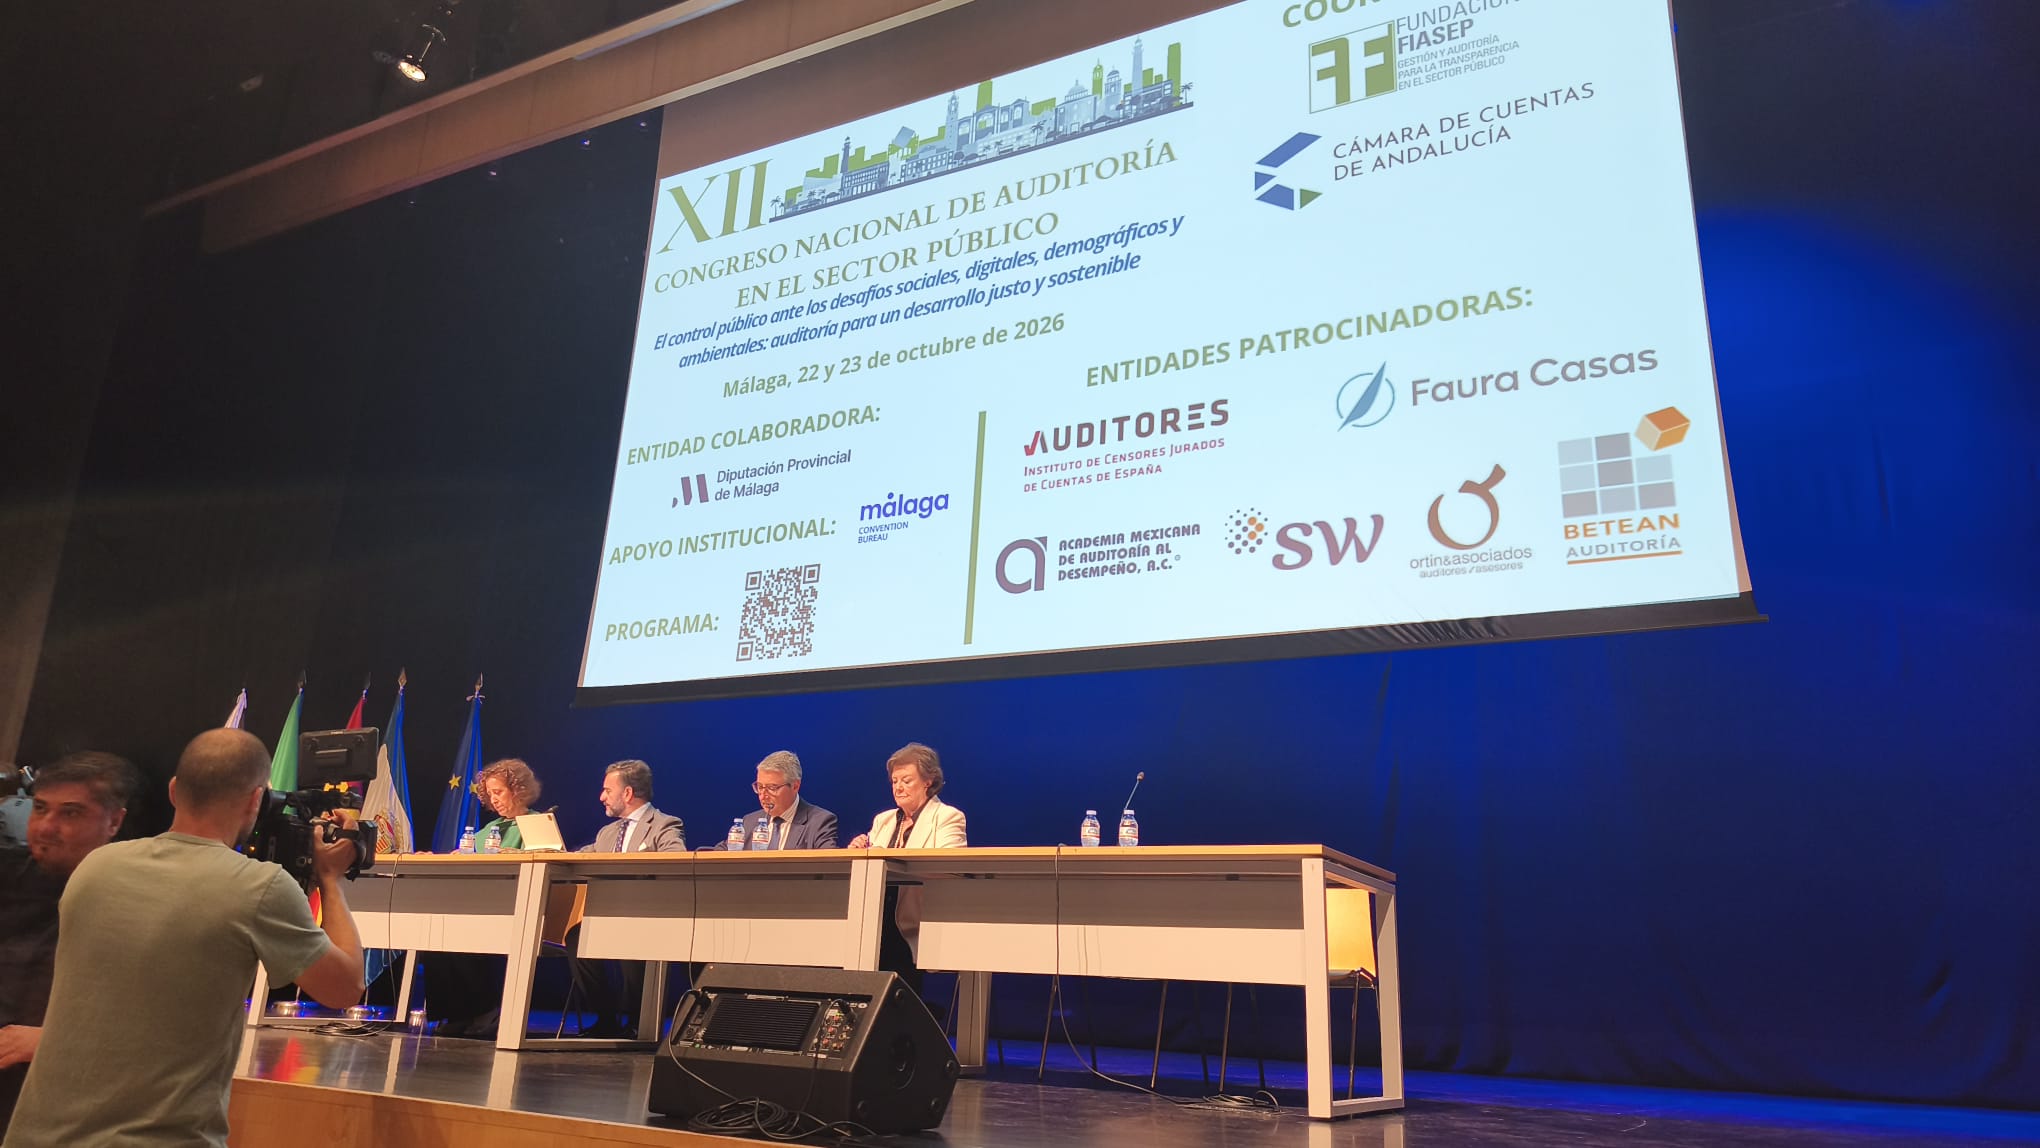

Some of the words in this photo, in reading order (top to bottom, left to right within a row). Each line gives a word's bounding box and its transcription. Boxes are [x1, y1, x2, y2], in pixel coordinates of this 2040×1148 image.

[1283, 0, 1380, 27] COO
[1396, 0, 1519, 34] FUNDACI
[1398, 18, 1474, 54] FIASEP
[1398, 50, 1437, 69] GESTIÓN
[1439, 48, 1445, 57] Y
[1447, 34, 1499, 55] AUDITORÍA
[1399, 66, 1423, 79] PARA
[1425, 63, 1437, 73] LA
[1439, 40, 1520, 68] TRANSPARENCIA
[1399, 80, 1411, 90] EN
[1413, 77, 1424, 87] EL
[1425, 66, 1462, 83] SECTOR
[1464, 55, 1505, 73] PÚBLICO
[1333, 123, 1430, 159] CÁMARA
[1439, 112, 1470, 133] DE
[1479, 82, 1594, 123] CUENTAS
[1334, 160, 1363, 181] DE
[1372, 125, 1511, 173] ANDALUCÍA
[654, 243, 787, 293] CONGRESO
[794, 204, 939, 258] NACIONAL
[946, 191, 985, 220] DE
[993, 139, 1178, 207] AUDITORÍA
[656, 159, 773, 254] XII
[734, 282, 770, 309] EN
[776, 274, 806, 299] EL
[812, 247, 919, 290] SECTOR
[927, 212, 1059, 263] PÚBLICO
[654, 333, 668, 350] El
[668, 322, 717, 346] control
[716, 312, 767, 342] público
[770, 304, 804, 324] ante
[806, 298, 827, 315] los
[830, 283, 892, 311] desafíos
[894, 268, 961, 294] sociales,
[965, 250, 1038, 281] digitales,
[1044, 217, 1167, 261] demográficos
[1169, 215, 1184, 237] y
[679, 337, 769, 368] ambientales:
[770, 321, 838, 349] auditoría
[839, 316, 876, 339] para
[880, 310, 901, 326] un
[903, 288, 985, 320] desarrollo
[985, 279, 1031, 306] justo
[1032, 276, 1046, 296] y
[1047, 252, 1141, 288] sostenible
[1086, 342, 1231, 387] ENTIDADES
[1239, 286, 1533, 359] PATROCINADORAS:
[722, 372, 792, 398] Málaga,
[797, 363, 819, 383] 22
[823, 363, 836, 383] y
[839, 355, 861, 376] 23
[866, 348, 891, 370] de
[896, 334, 975, 364] octubre
[982, 327, 1006, 347] de
[1014, 313, 1065, 340] 2026
[1411, 369, 1519, 406] Faura
[1530, 349, 1658, 386] Casas
[626, 436, 705, 465] ENTIDAD
[710, 404, 880, 450] COLABORADORA:
[1023, 399, 1229, 456] AUDITORES
[717, 460, 784, 484] Diputación
[787, 449, 851, 472] Provincial
[1024, 460, 1082, 477] INSTITUTO
[1086, 457, 1100, 468] DE
[1104, 446, 1166, 465] CENSORES
[1170, 438, 1225, 457] JURADOS
[714, 487, 730, 501] de
[733, 481, 779, 499] Málaga
[1024, 482, 1037, 492] DE
[1041, 474, 1092, 490] CUENTAS
[1096, 471, 1110, 482] DE
[1114, 463, 1162, 480] ESPAÑA
[608, 539, 673, 565] APOYO
[677, 517, 836, 555] INSTITUCIONAL:
[858, 533, 888, 544] BUREAU
[859, 521, 909, 535] CONVENTION
[1059, 533, 1125, 551] ACADEMIA
[1130, 524, 1200, 543] MEXICANA
[1564, 514, 1680, 539] BETEAN
[1058, 554, 1075, 566] DE
[1079, 544, 1150, 564] AUDITORÍA
[1156, 543, 1172, 555] AL
[1567, 534, 1681, 558] AUDITORÍA
[1058, 561, 1141, 581] DESEMPEÑO,
[605, 612, 719, 641] PROGRAMA:
